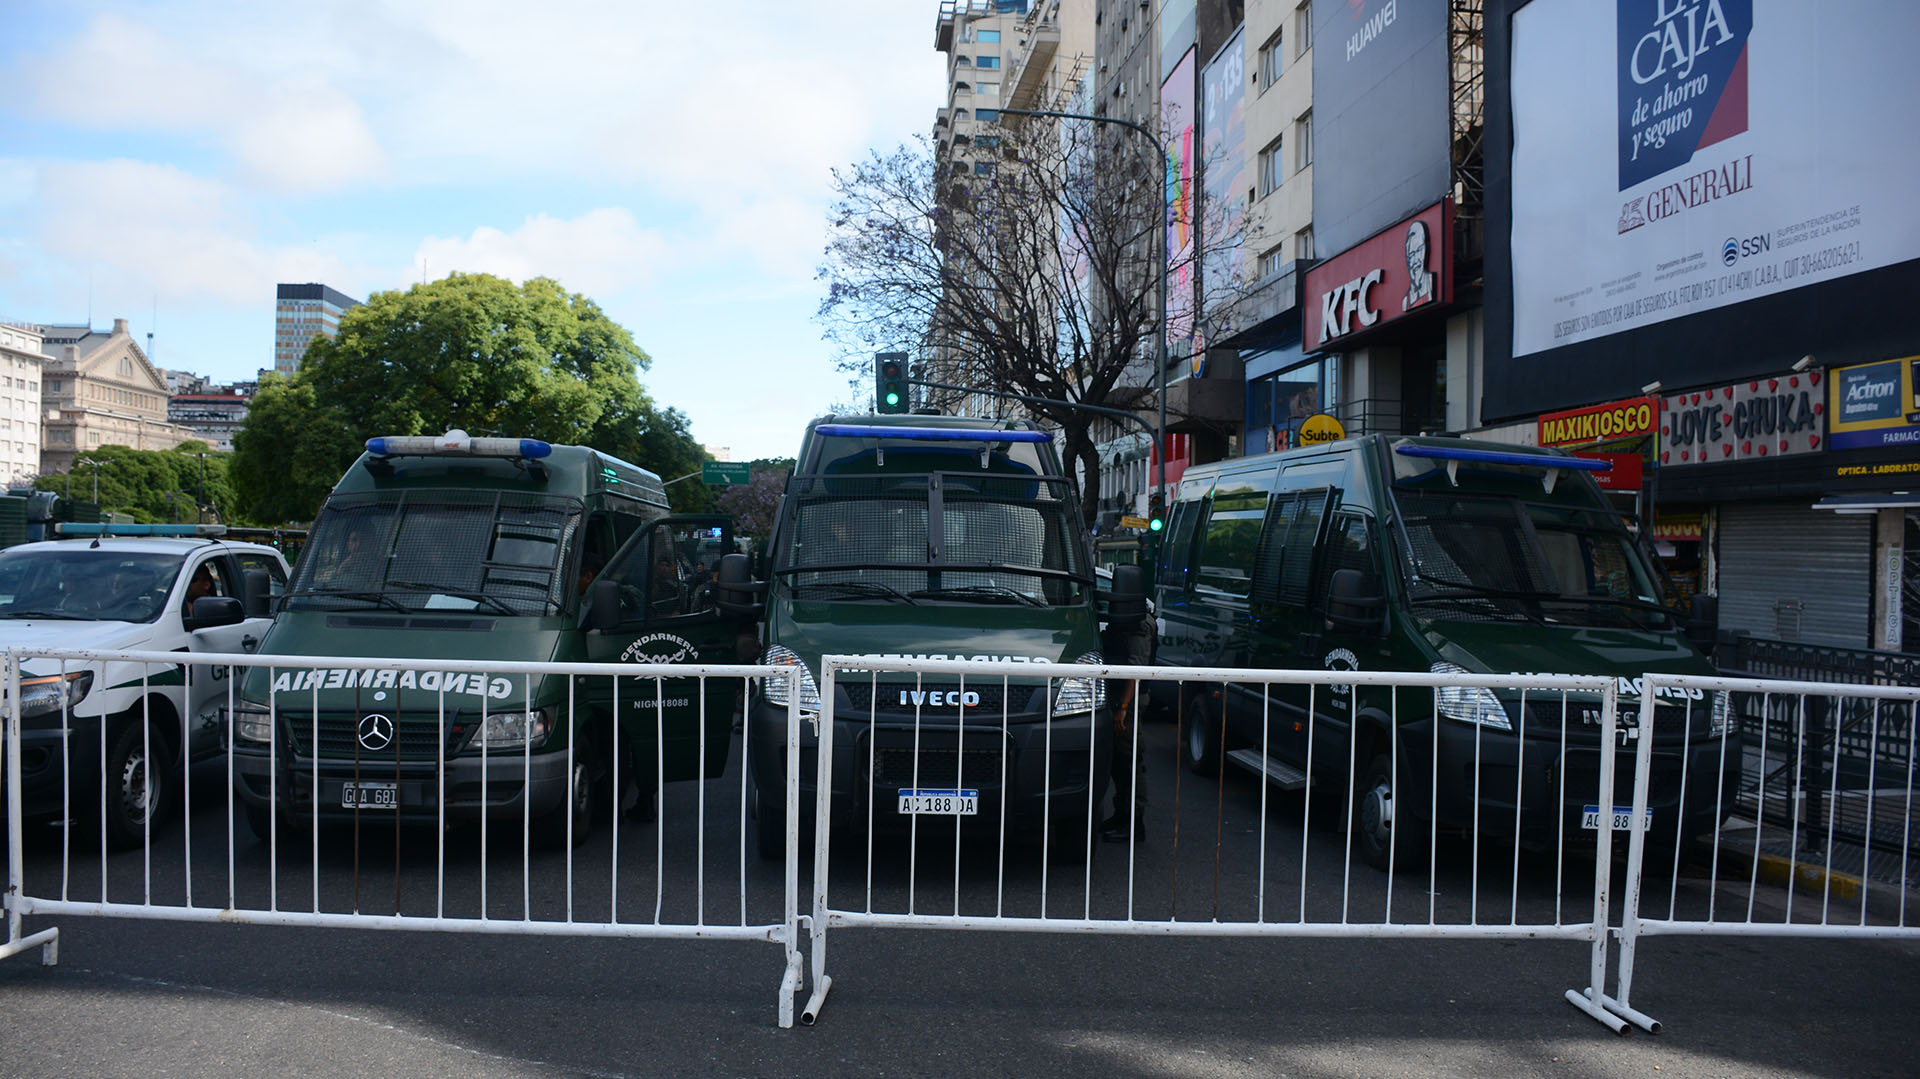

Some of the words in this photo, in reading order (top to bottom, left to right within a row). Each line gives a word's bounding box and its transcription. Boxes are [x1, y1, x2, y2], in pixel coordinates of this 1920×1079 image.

[1346, 0, 1397, 61] HUAWEI
[1630, 0, 1734, 84] CAJA
[1631, 97, 1648, 127] de
[1652, 73, 1708, 117] ahorro
[1630, 131, 1642, 161] y
[1643, 107, 1693, 149] seguro
[1647, 155, 1753, 223] GENERALI
[1777, 209, 1848, 238] SUPERINTENDENCIA
[1850, 204, 1861, 216] DE
[1741, 232, 1771, 258] SSN
[1777, 232, 1809, 249] SEGUROS
[1810, 229, 1820, 239] DE
[1821, 225, 1832, 237] LA
[1643, 291, 1667, 314] SEGUROS
[1784, 257, 1800, 279] CUIT
[1318, 268, 1382, 344] KFC
[1846, 380, 1894, 401] Actron
[1542, 403, 1652, 444] MAXIKIOSCO
[1670, 403, 1723, 447] LOVE
[1733, 391, 1816, 439] CHUKA
[1305, 428, 1340, 441] Subte
[1883, 430, 1920, 443] FARMAC
[1837, 465, 1868, 476] OPTICA
[1873, 462, 1920, 474] LABORATO
[1886, 557, 1900, 643] OPTICA
[620, 632, 699, 662] GENDARMERIA
[634, 700, 658, 709] NIGN
[661, 698, 689, 707] 18088
[899, 690, 980, 707] IVECO
[1583, 709, 1641, 725] IVEC
[374, 788, 397, 804] 681
[925, 798, 951, 812] 188
